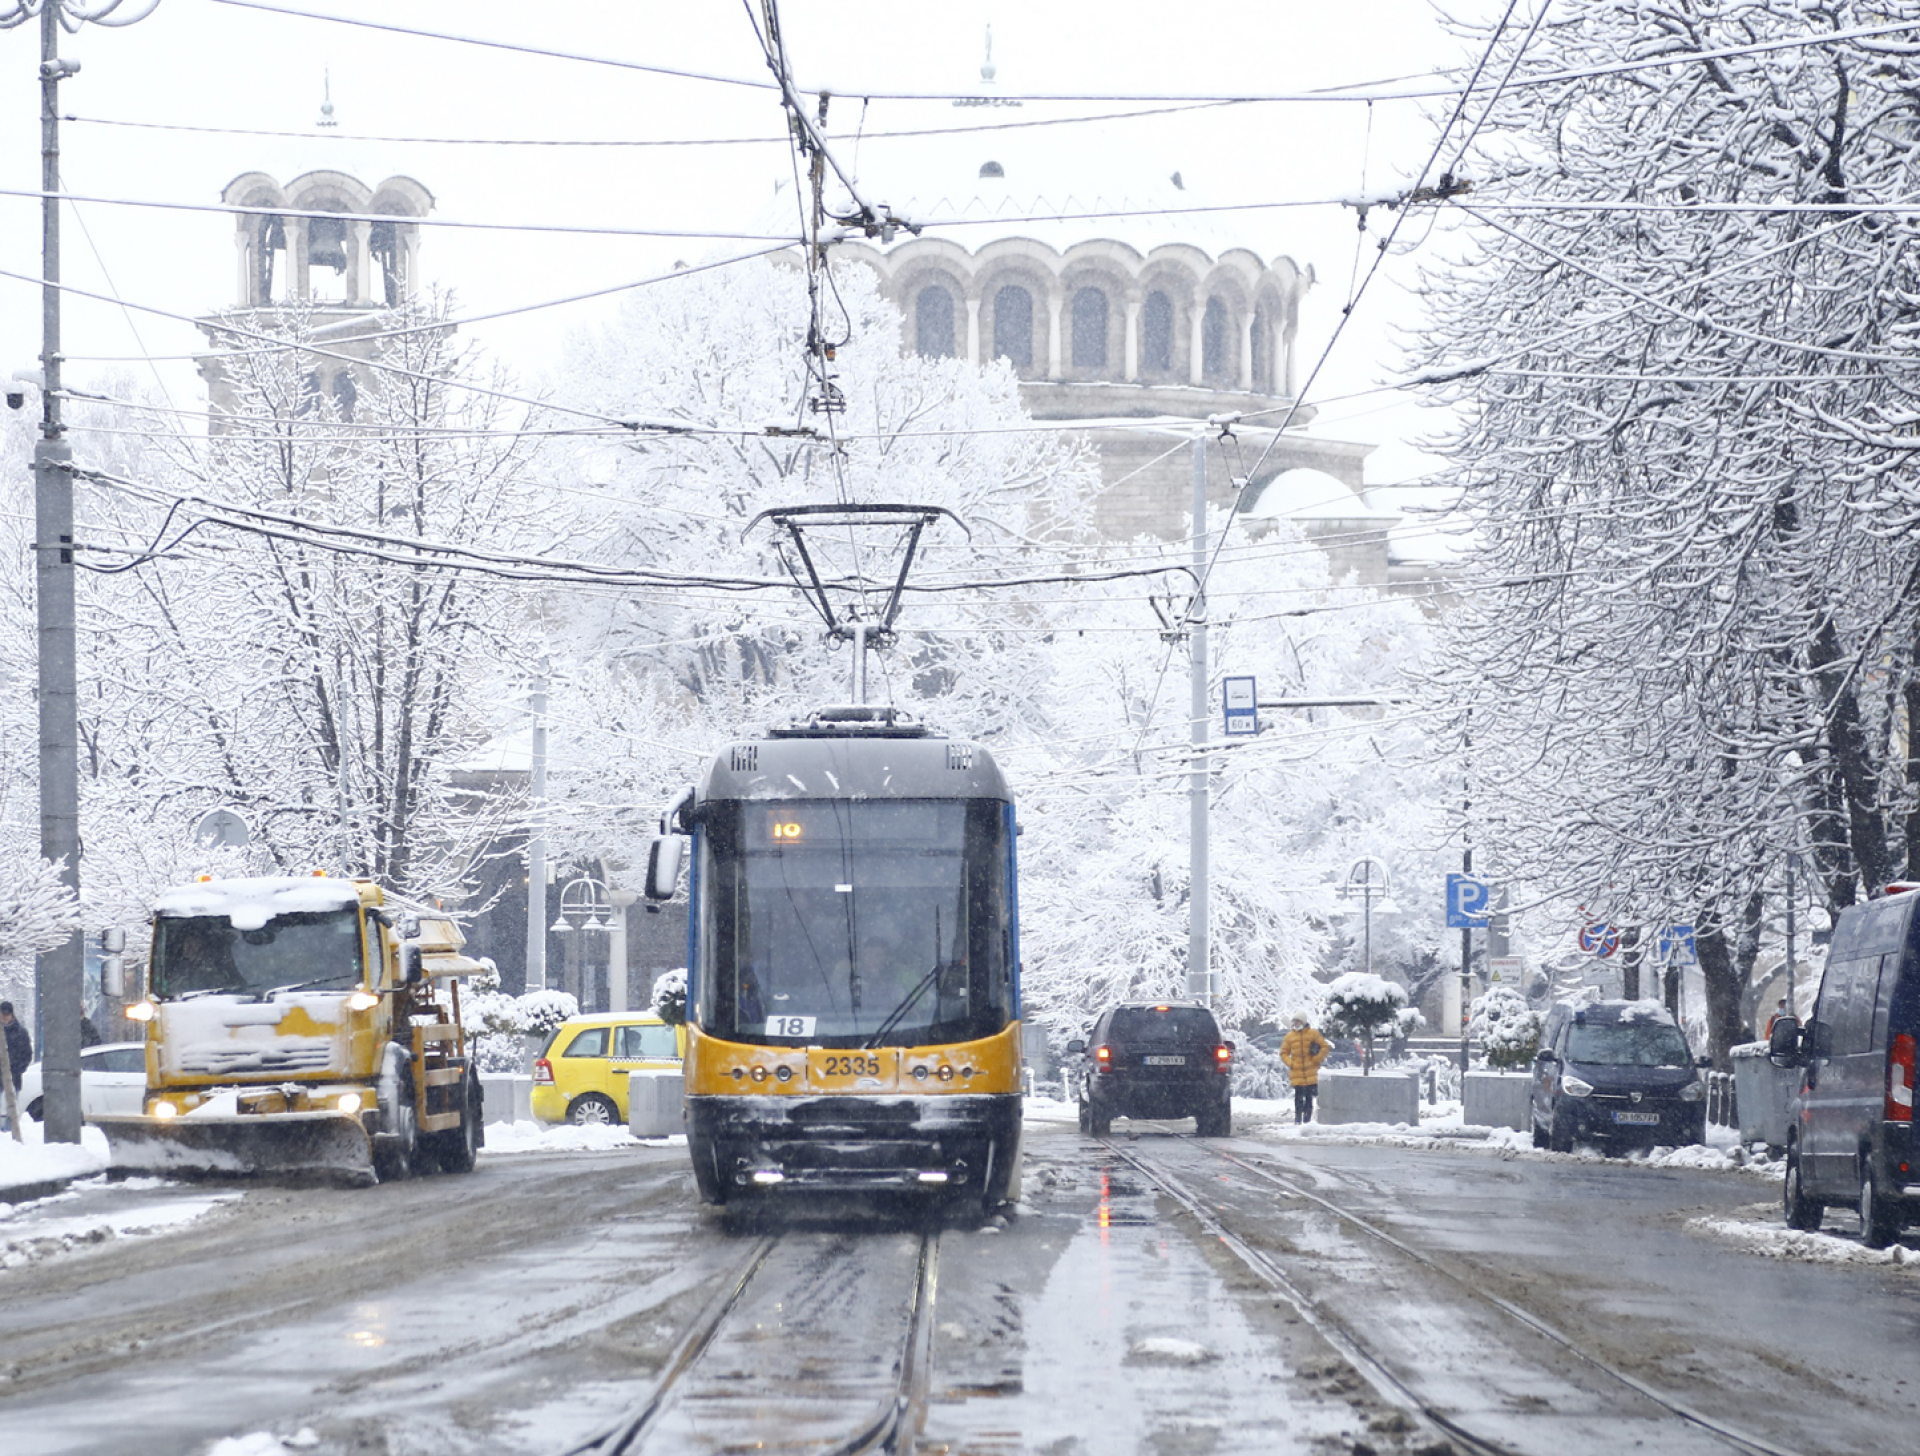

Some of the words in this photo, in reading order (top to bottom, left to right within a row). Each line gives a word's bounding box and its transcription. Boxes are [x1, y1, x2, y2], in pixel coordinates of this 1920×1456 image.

[1232, 719, 1243, 729] 60
[1458, 882, 1480, 913] P
[777, 1017, 804, 1035] 18
[825, 1056, 880, 1076] 2335
